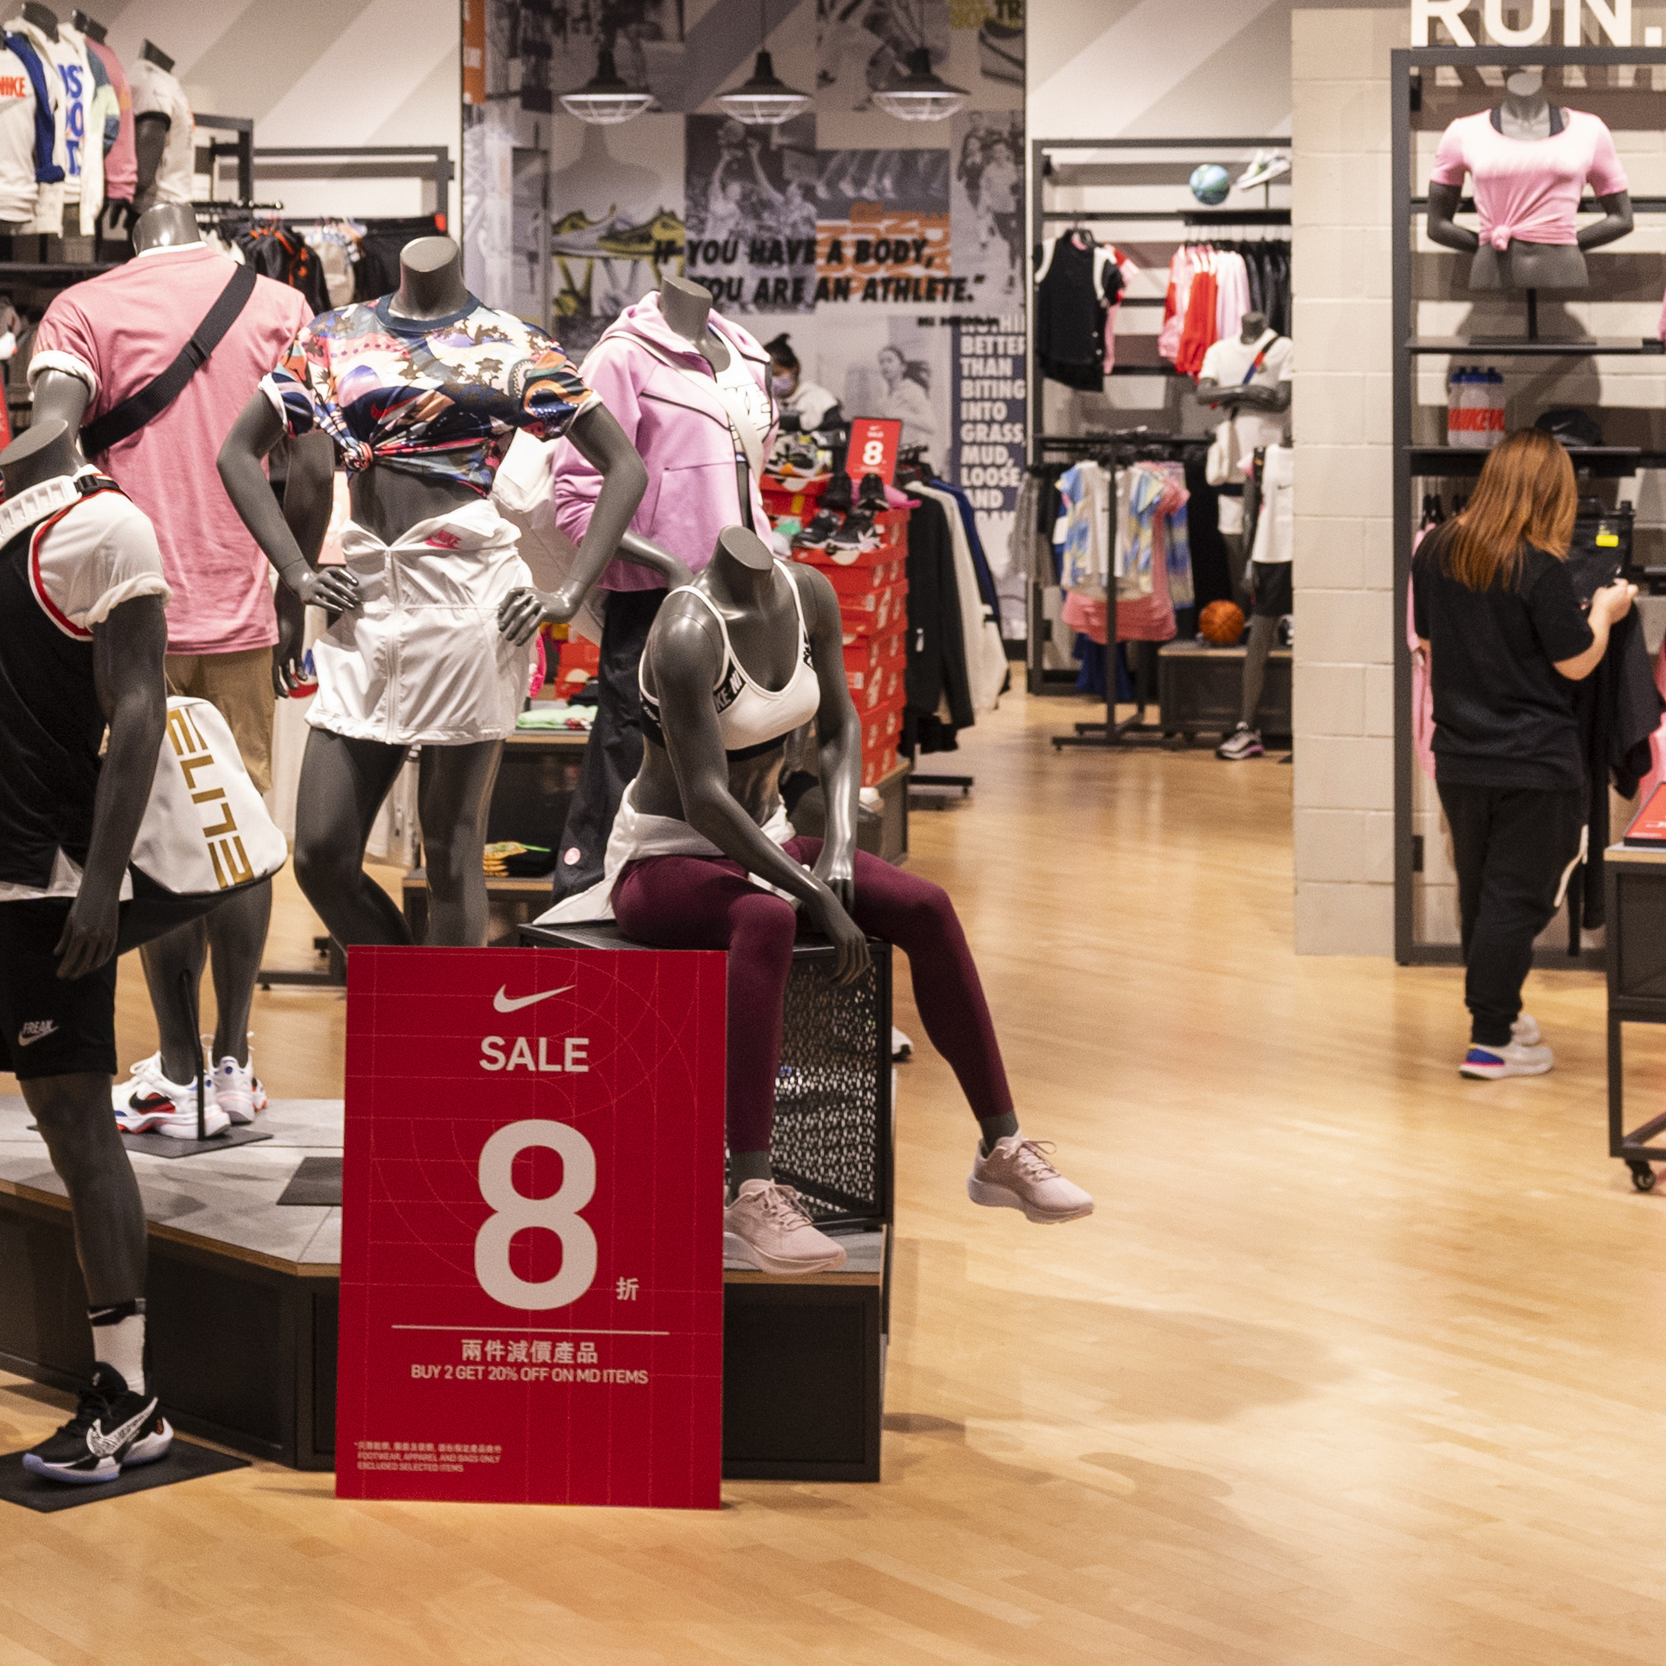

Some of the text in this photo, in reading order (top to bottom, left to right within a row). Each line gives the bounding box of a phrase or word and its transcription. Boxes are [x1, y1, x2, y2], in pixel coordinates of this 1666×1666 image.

[686, 238, 740, 266] YOU
[748, 238, 818, 265] HAVE
[825, 239, 844, 265] A
[854, 238, 934, 269] BODY,
[752, 276, 807, 302] ARE
[814, 277, 853, 302] AN
[959, 356, 1014, 378] THAN
[959, 378, 1026, 400] BITING
[960, 400, 1008, 421] INTO
[862, 439, 884, 466] 8
[960, 444, 1015, 469] MUD,
[166, 707, 255, 890] ELITE
[478, 1035, 590, 1073] SALE
[473, 1118, 599, 1311] 8
[615, 1276, 640, 1301] 折
[460, 1338, 599, 1364] 兩件減價產品
[410, 1363, 649, 1384] BUY 2 GET 20% OFF ON MD ITEMS
